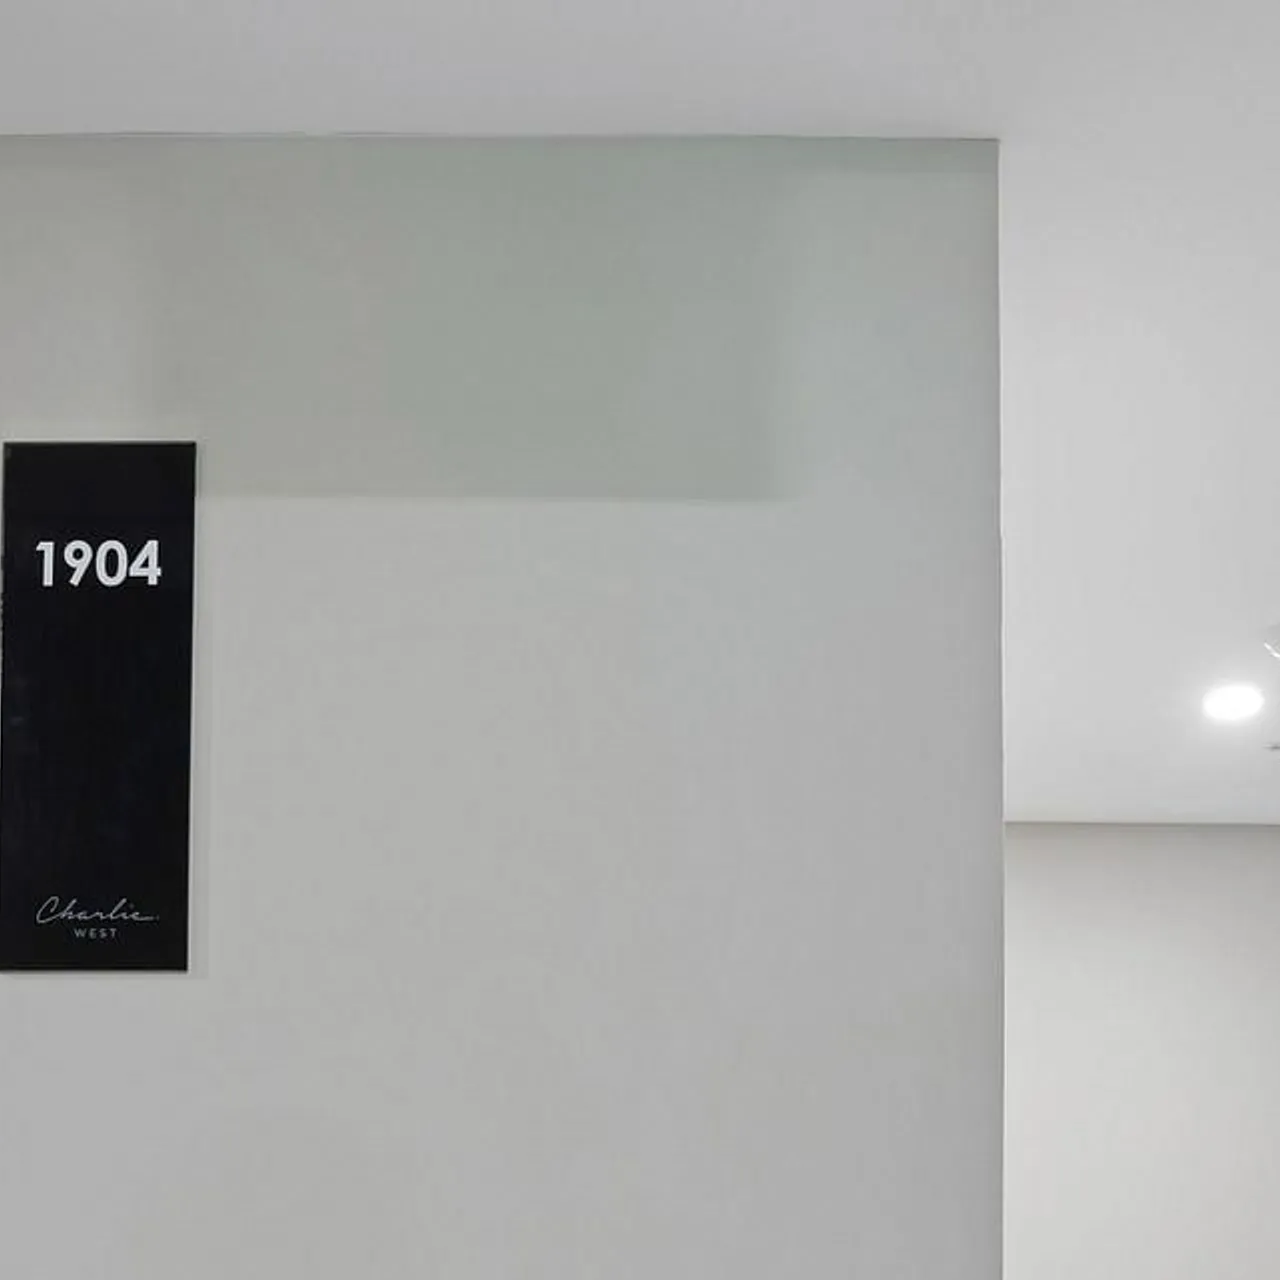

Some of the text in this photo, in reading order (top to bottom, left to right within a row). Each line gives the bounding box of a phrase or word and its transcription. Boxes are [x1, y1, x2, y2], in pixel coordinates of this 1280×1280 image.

[35, 539, 162, 587] 1904
[35, 896, 160, 924] Charlie
[73, 927, 118, 940] WEST
